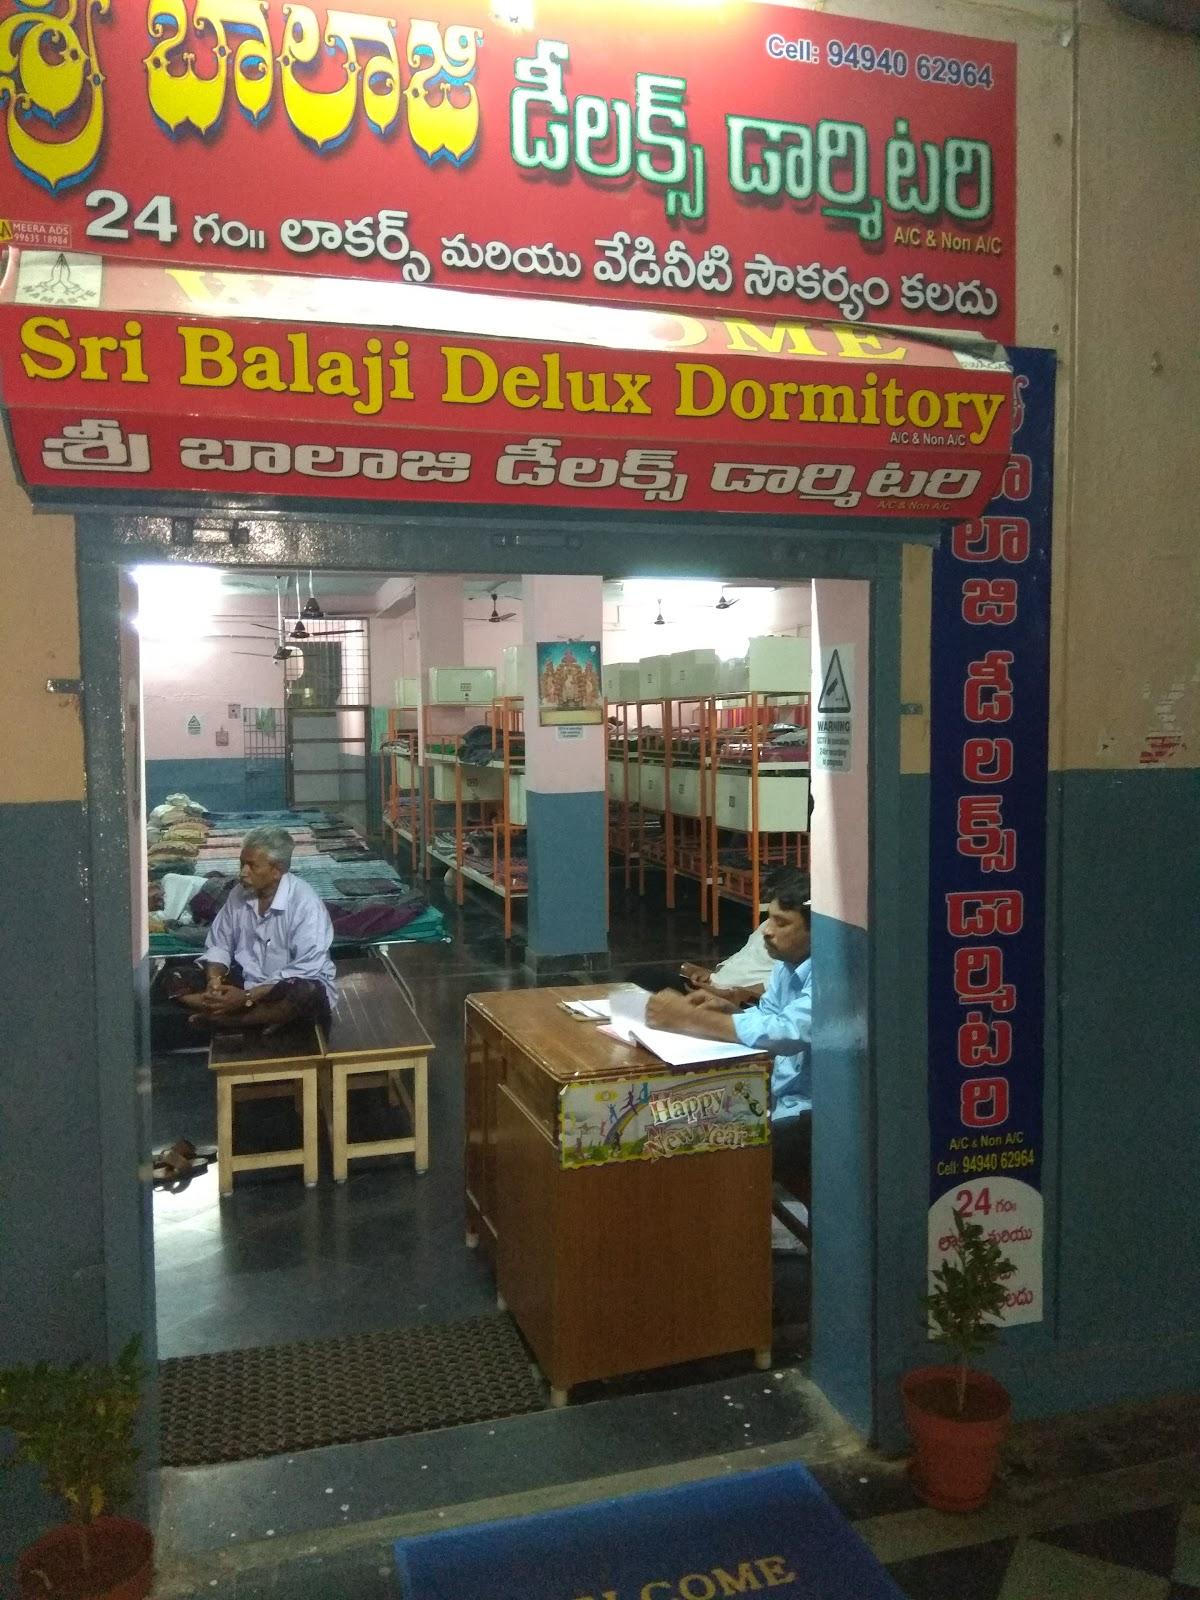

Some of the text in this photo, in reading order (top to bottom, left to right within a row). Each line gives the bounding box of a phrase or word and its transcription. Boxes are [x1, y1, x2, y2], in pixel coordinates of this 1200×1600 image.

[766, 34, 994, 90] Cell: 94940 62964
[13, 222, 70, 236] MEERA ADS
[13, 232, 40, 243] 99635
[893, 226, 1003, 256] A/C & Non A/C
[86, 189, 178, 243] 24
[440, 234, 582, 279] మరియు
[900, 273, 1000, 317] కలదు
[19, 315, 150, 384] Sri
[177, 324, 416, 416] Balaji
[440, 344, 653, 416] Delux
[674, 361, 1006, 446] Dormitory
[41, 418, 151, 474] శ్రీ
[889, 431, 967, 448] A/C & Non A/C
[817, 720, 851, 732] WARNING
[650, 1088, 725, 1126] Happy
[644, 1120, 748, 1160] New Year
[980, 1134, 1002, 1147] Non
[962, 1154, 998, 1173] 94940
[1000, 1149, 1035, 1168] 62964
[956, 1187, 992, 1218] 24
